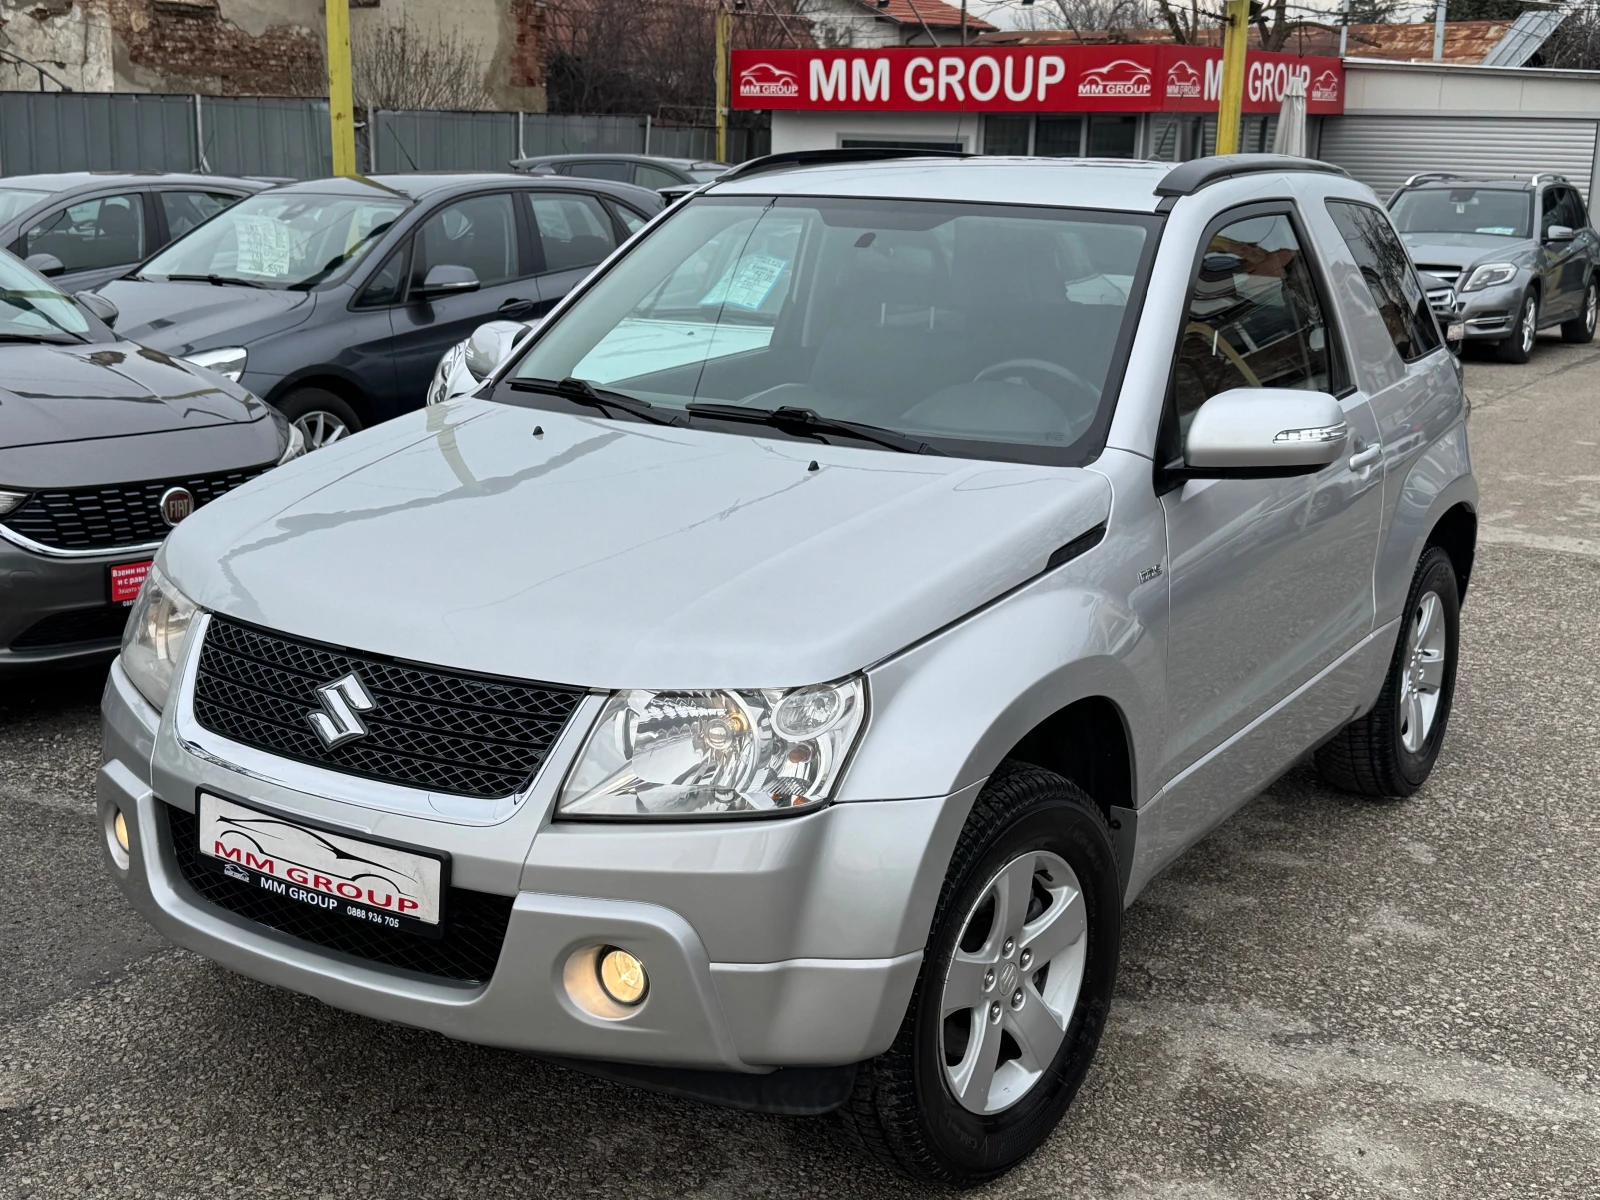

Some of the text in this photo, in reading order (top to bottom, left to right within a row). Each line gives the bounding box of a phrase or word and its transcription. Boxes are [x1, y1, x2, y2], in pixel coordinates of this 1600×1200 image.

[740, 84, 798, 95] MM GROUP
[809, 56, 1065, 102] MM GROUP
[1078, 84, 1151, 95] MM GROUP
[1204, 58, 1223, 101] M
[170, 499, 188, 518] FIAT
[112, 566, 136, 577] Вземи
[136, 566, 146, 575] на
[214, 840, 419, 912] MM GROUP
[260, 876, 399, 928] MM GROUP 0888 936 705
